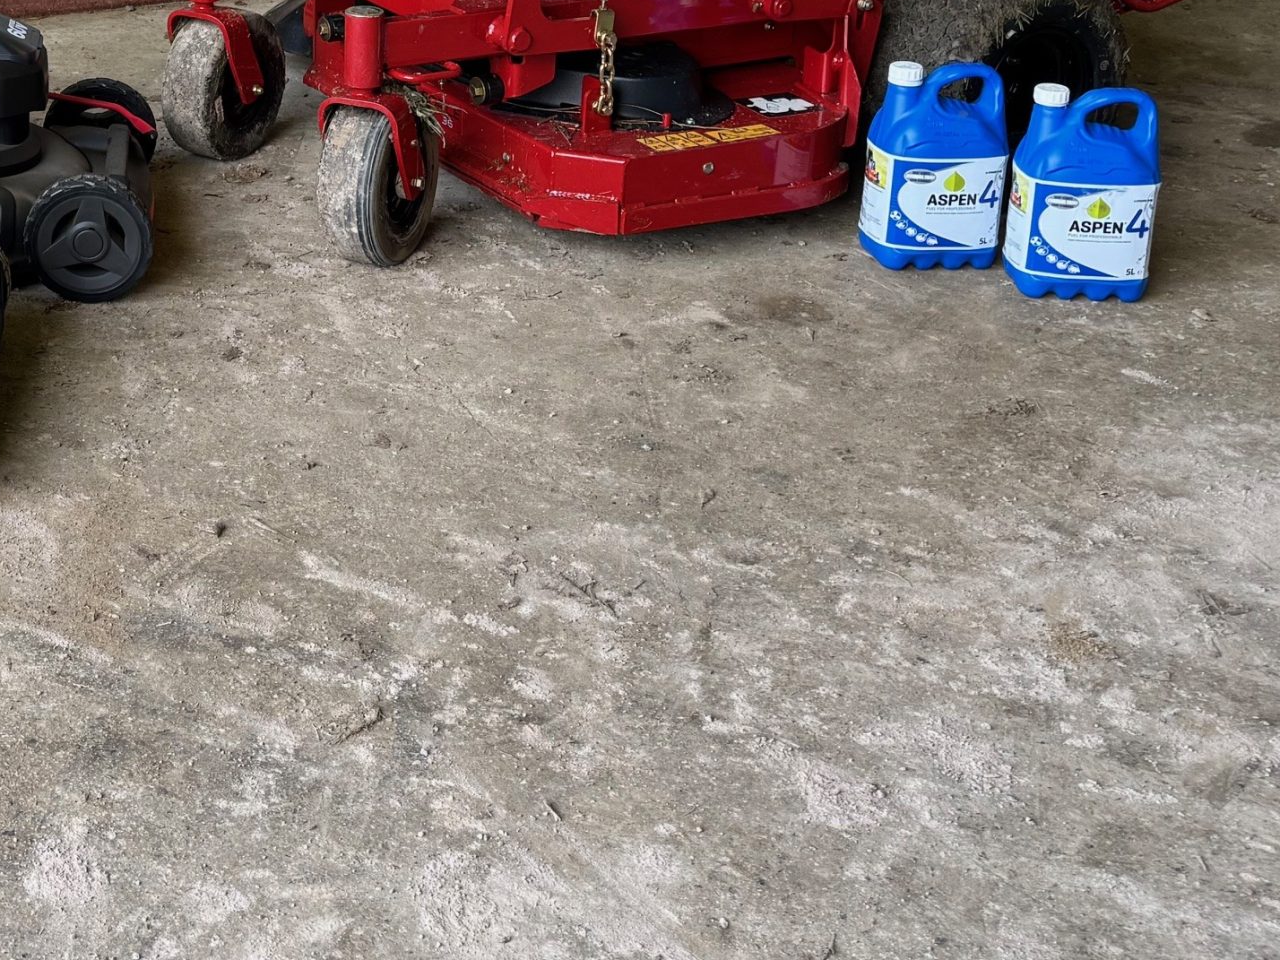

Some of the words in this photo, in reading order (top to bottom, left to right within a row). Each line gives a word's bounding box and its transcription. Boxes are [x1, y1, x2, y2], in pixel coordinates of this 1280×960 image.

[927, 193, 977, 206] ASPEN
[978, 180, 998, 209] 4
[1069, 220, 1123, 234] ASPEN
[1125, 209, 1149, 238] 4
